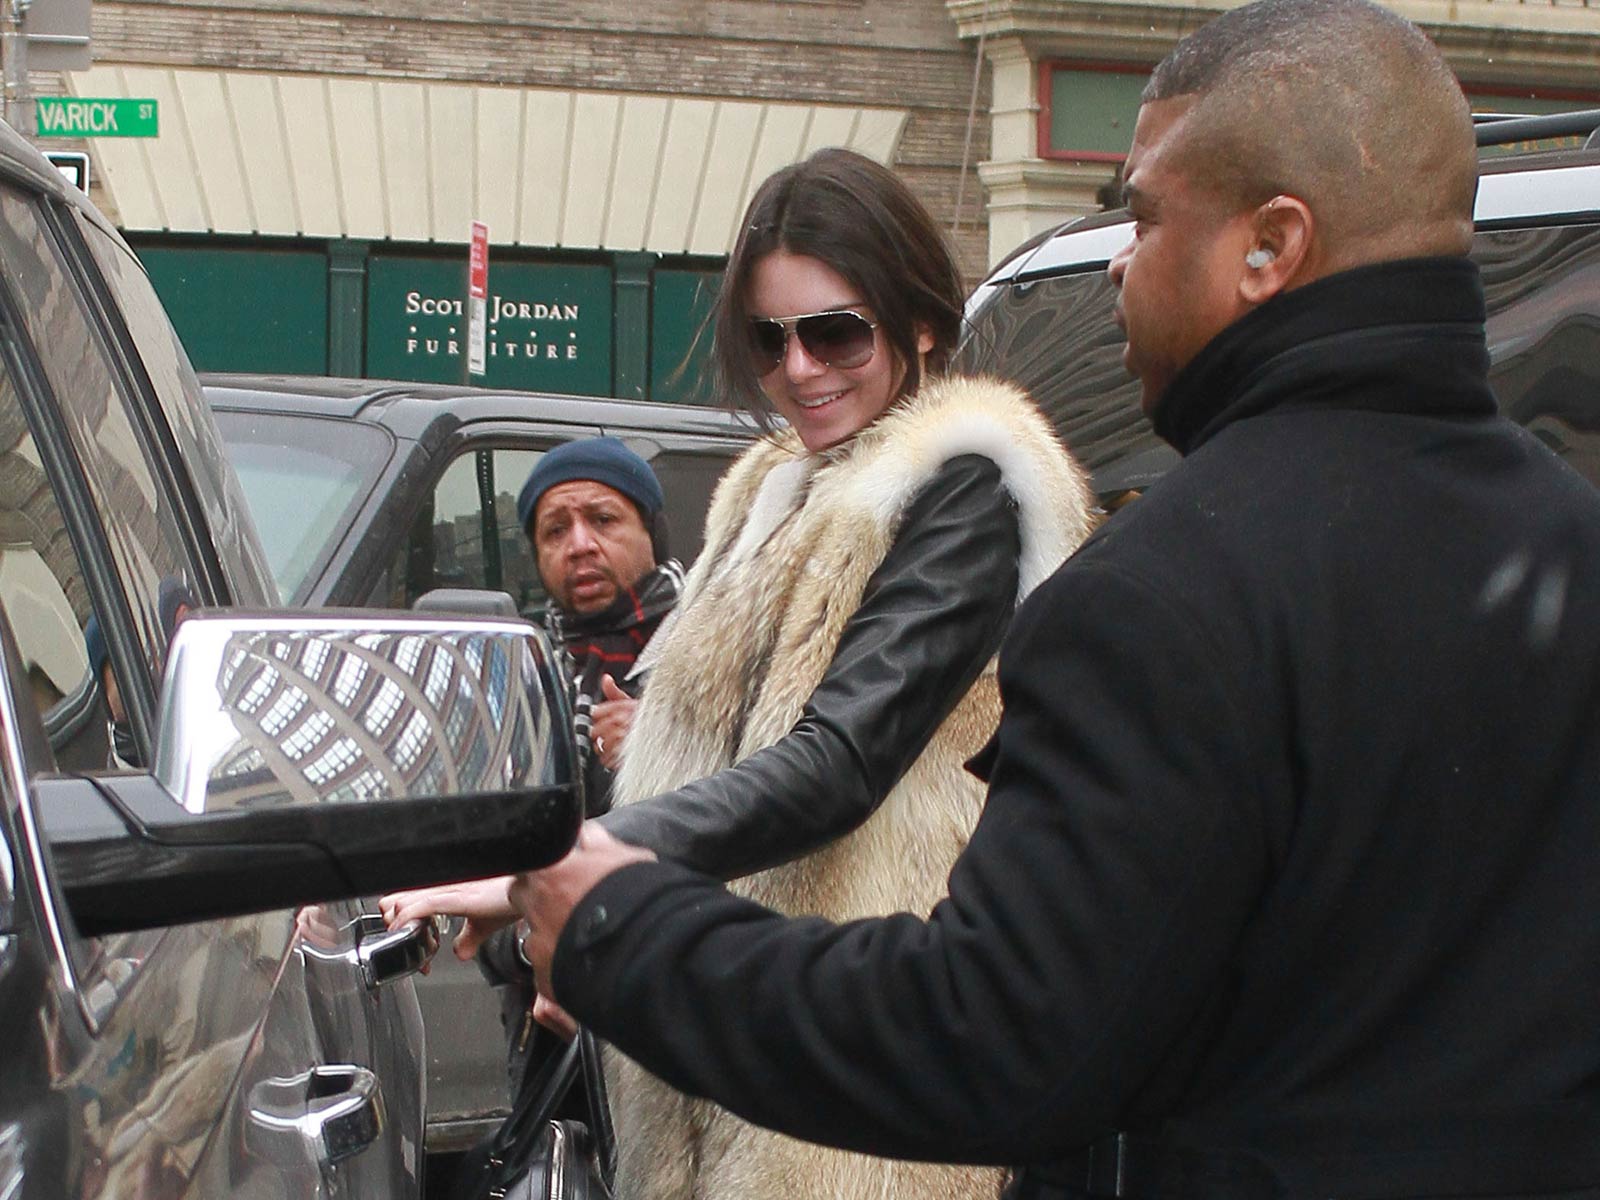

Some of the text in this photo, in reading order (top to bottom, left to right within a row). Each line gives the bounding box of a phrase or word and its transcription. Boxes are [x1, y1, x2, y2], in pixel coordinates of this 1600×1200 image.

[39, 102, 153, 131] VARICK ST
[406, 292, 579, 323] SCOT JORDAN
[407, 339, 578, 359] FURITURE
